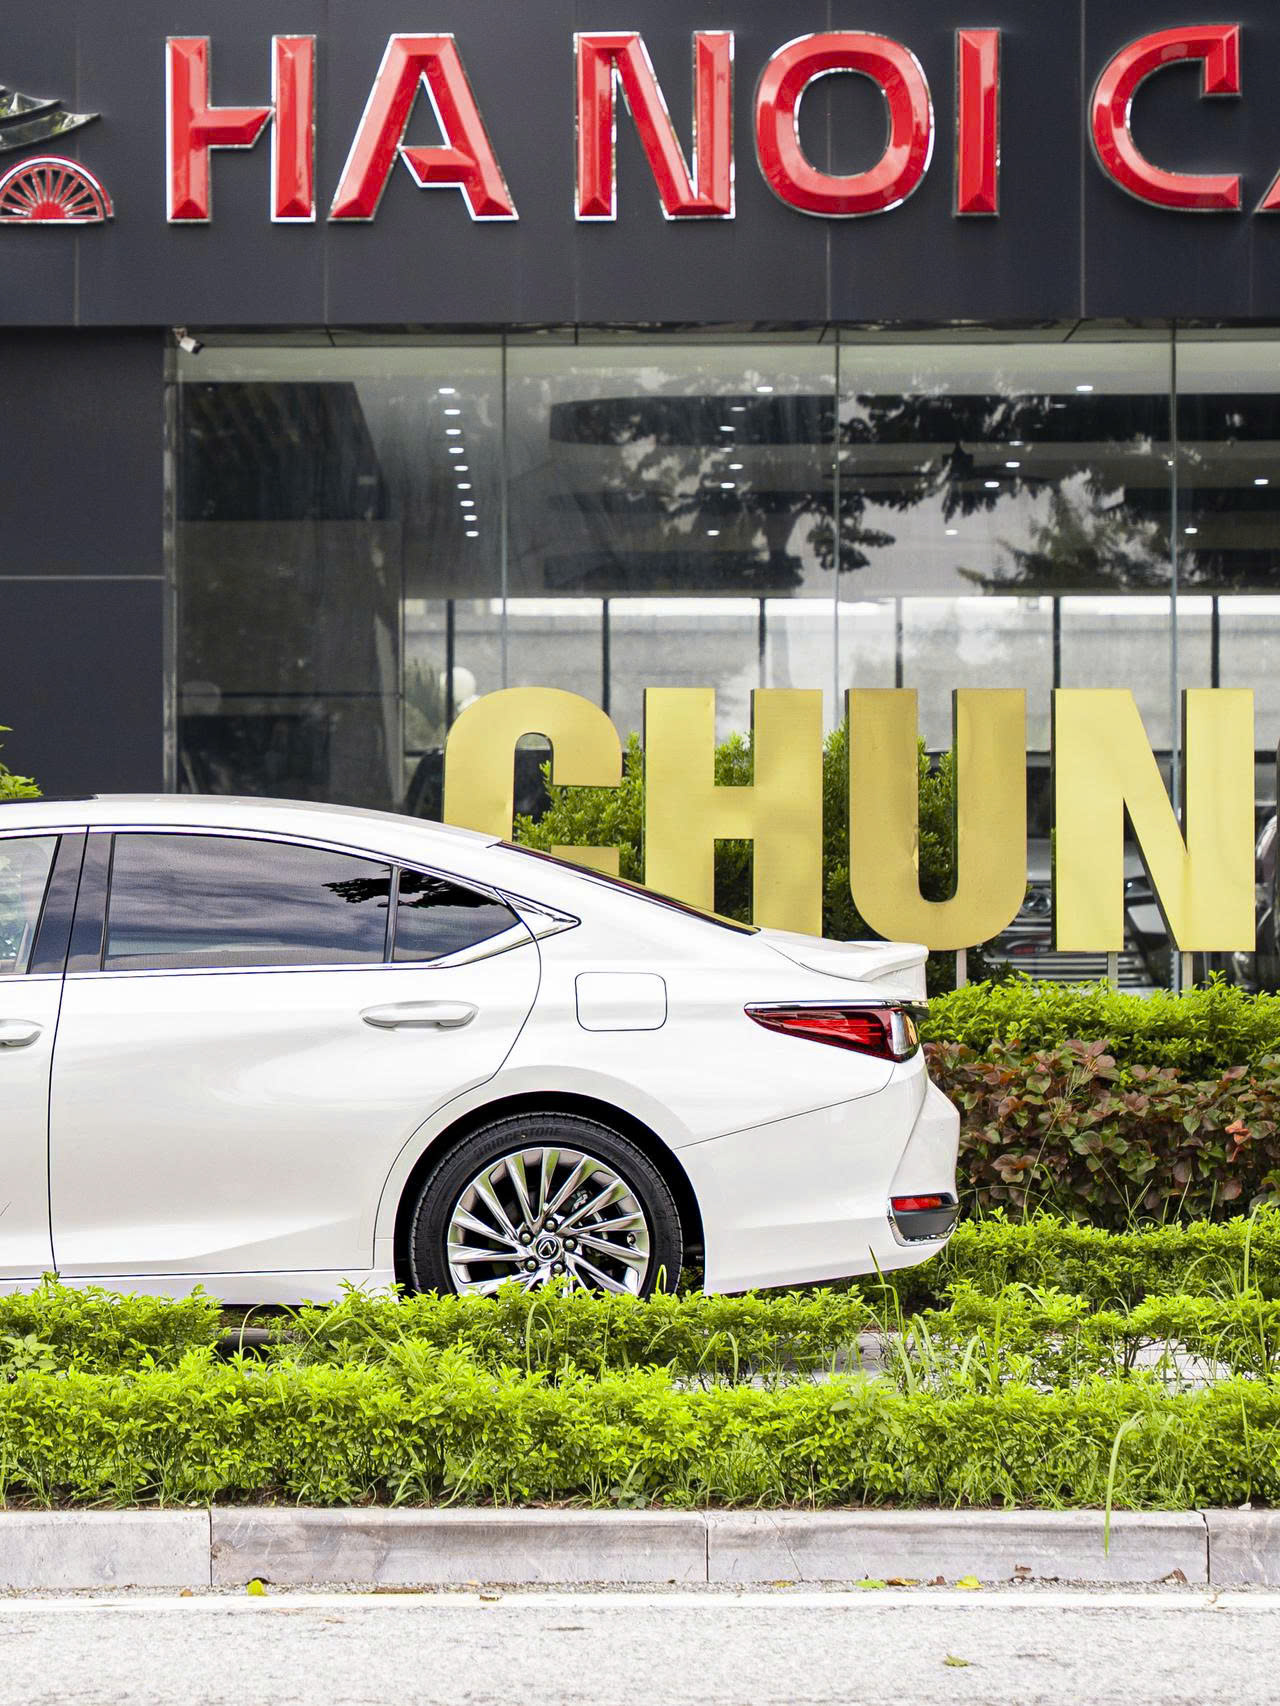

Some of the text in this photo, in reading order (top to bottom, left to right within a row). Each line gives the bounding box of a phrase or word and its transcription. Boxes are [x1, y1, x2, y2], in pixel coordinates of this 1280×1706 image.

[165, 22, 1280, 224] HA NOI C
[443, 685, 1280, 952] CHUN
